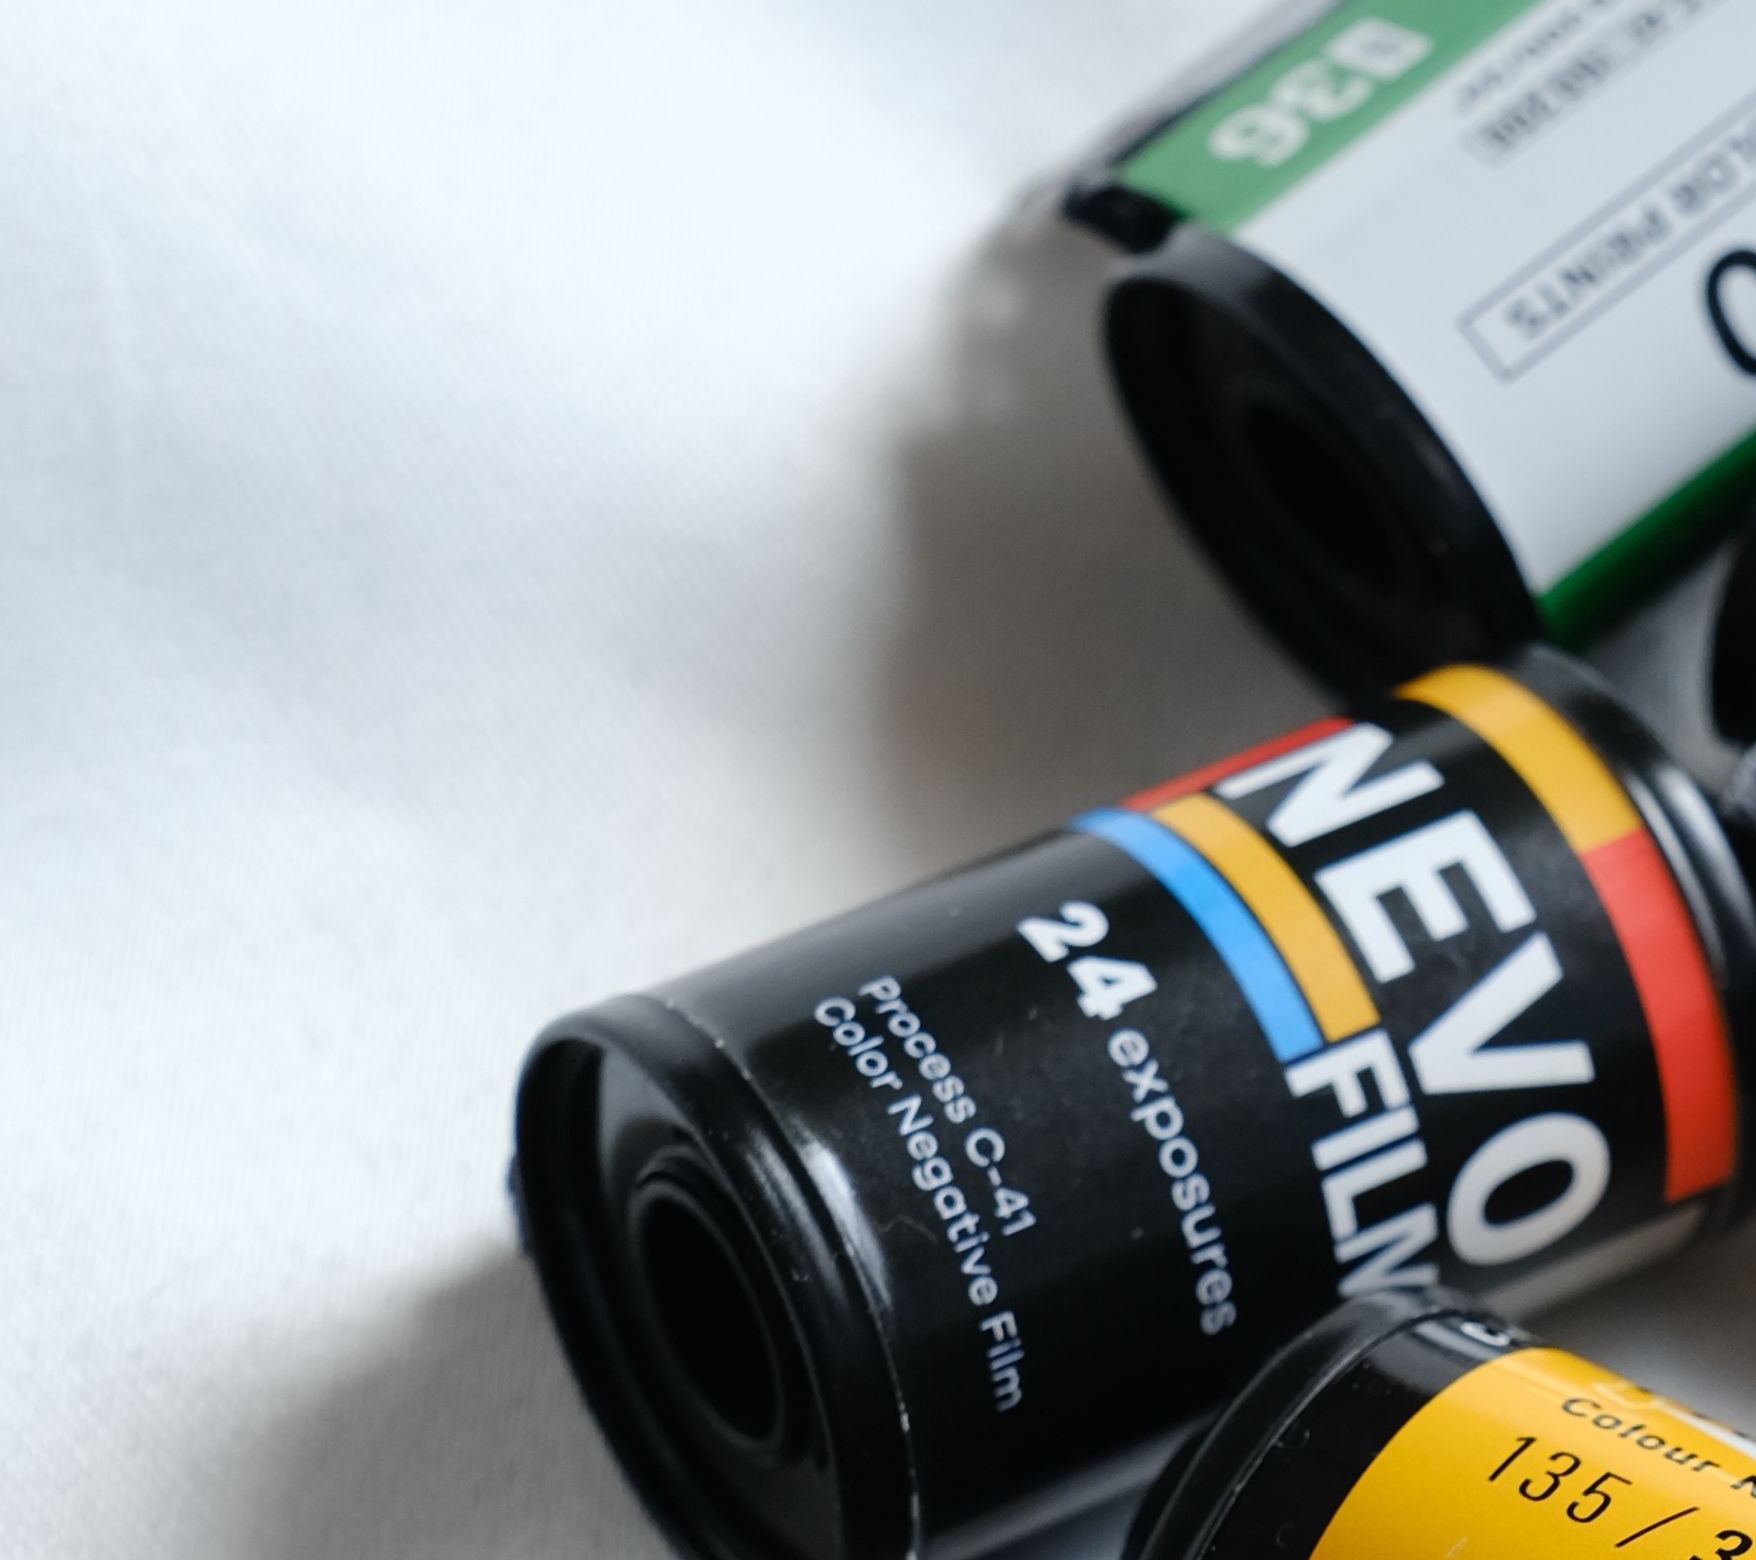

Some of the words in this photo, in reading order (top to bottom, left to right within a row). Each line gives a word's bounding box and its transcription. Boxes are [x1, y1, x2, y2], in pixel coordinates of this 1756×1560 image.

[1507, 208, 1670, 337] PRINTS
[858, 975, 976, 1126] Process
[966, 1129, 1035, 1235] C-41
[1018, 902, 1156, 1019] 24
[1108, 1029, 1234, 1332] exposures
[1216, 726, 1607, 1262] NEVO
[814, 986, 902, 1089] Color
[888, 1095, 997, 1304] Negative
[980, 1311, 1023, 1409] Film
[1488, 1437, 1630, 1523] 135
[1557, 1389, 1720, 1478] Colour
